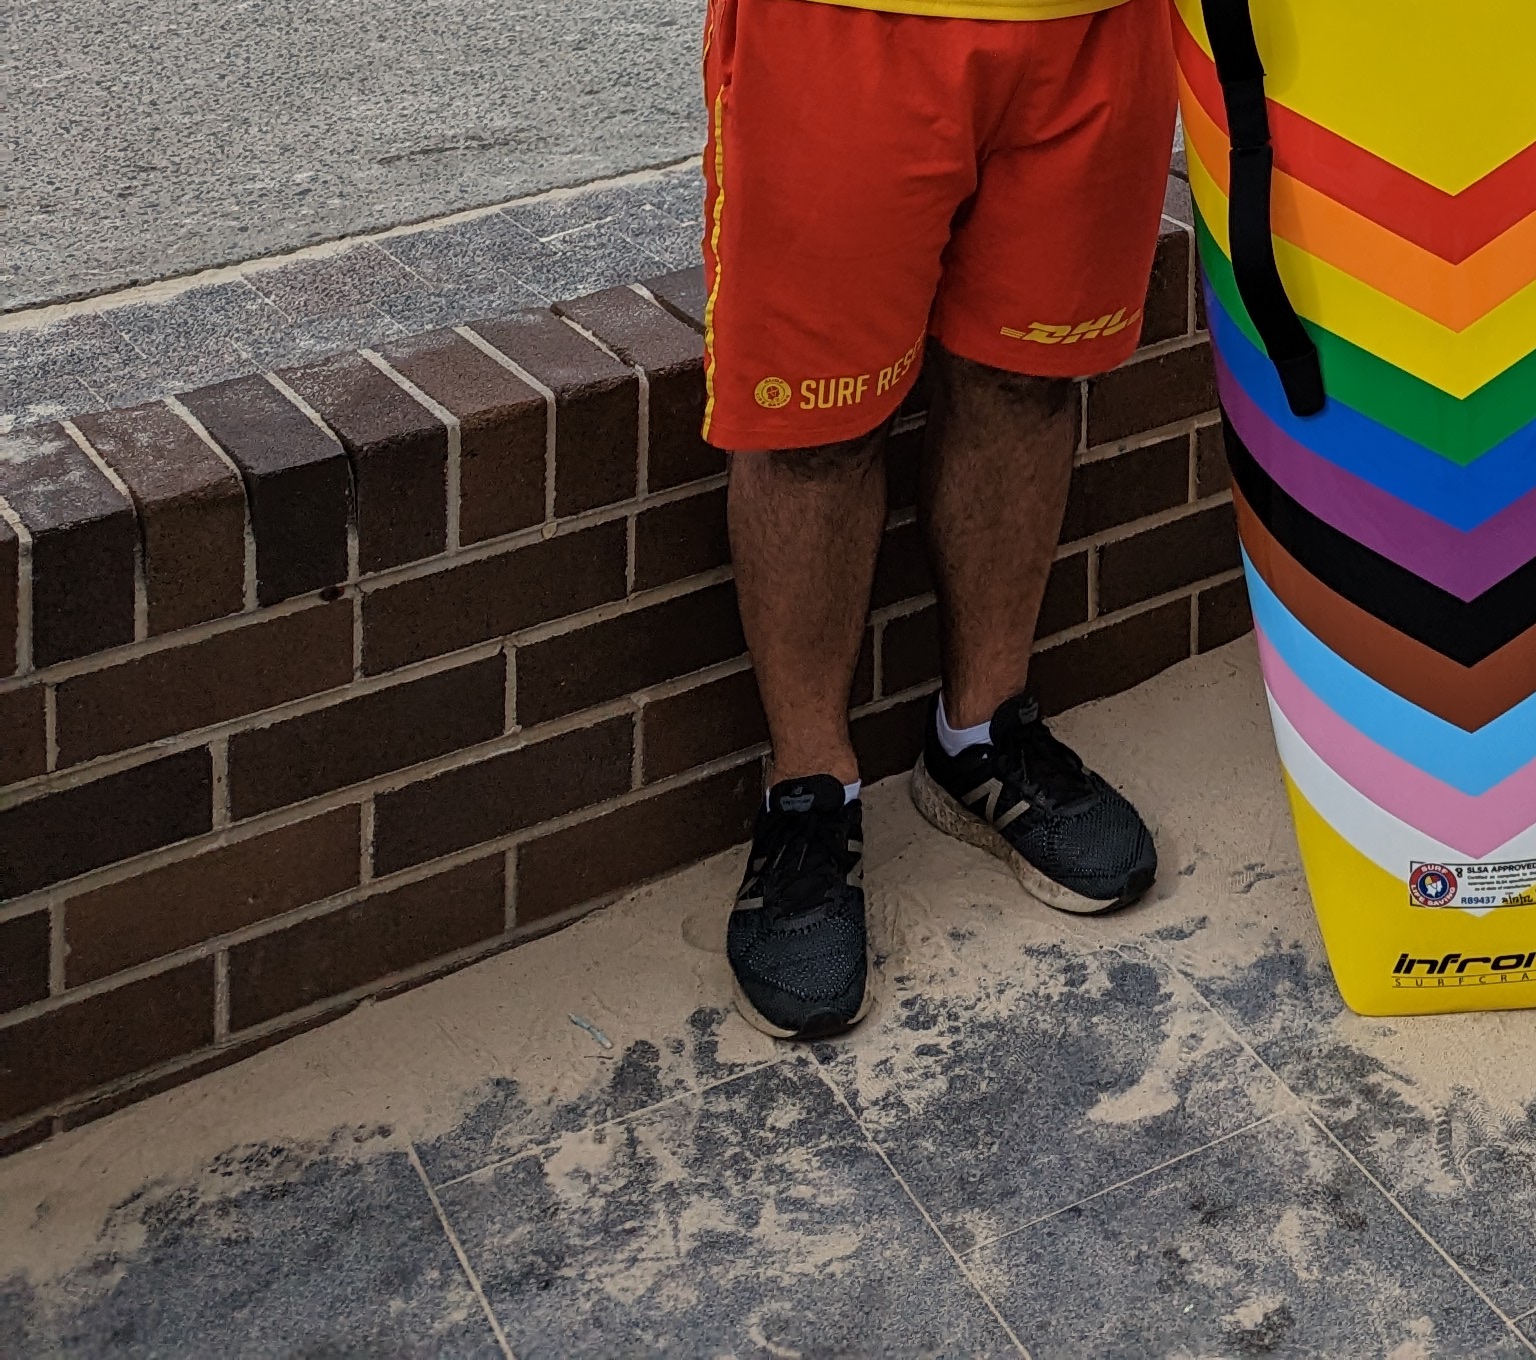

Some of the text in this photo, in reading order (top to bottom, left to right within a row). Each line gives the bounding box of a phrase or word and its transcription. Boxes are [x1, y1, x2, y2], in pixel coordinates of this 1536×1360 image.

[1022, 306, 1130, 345] DHL
[800, 374, 870, 410] SURF
[1420, 864, 1449, 874] SURF
[1467, 866, 1489, 874] SLSA
[1411, 884, 1426, 903] LIFE
[1427, 886, 1456, 906] SAVING
